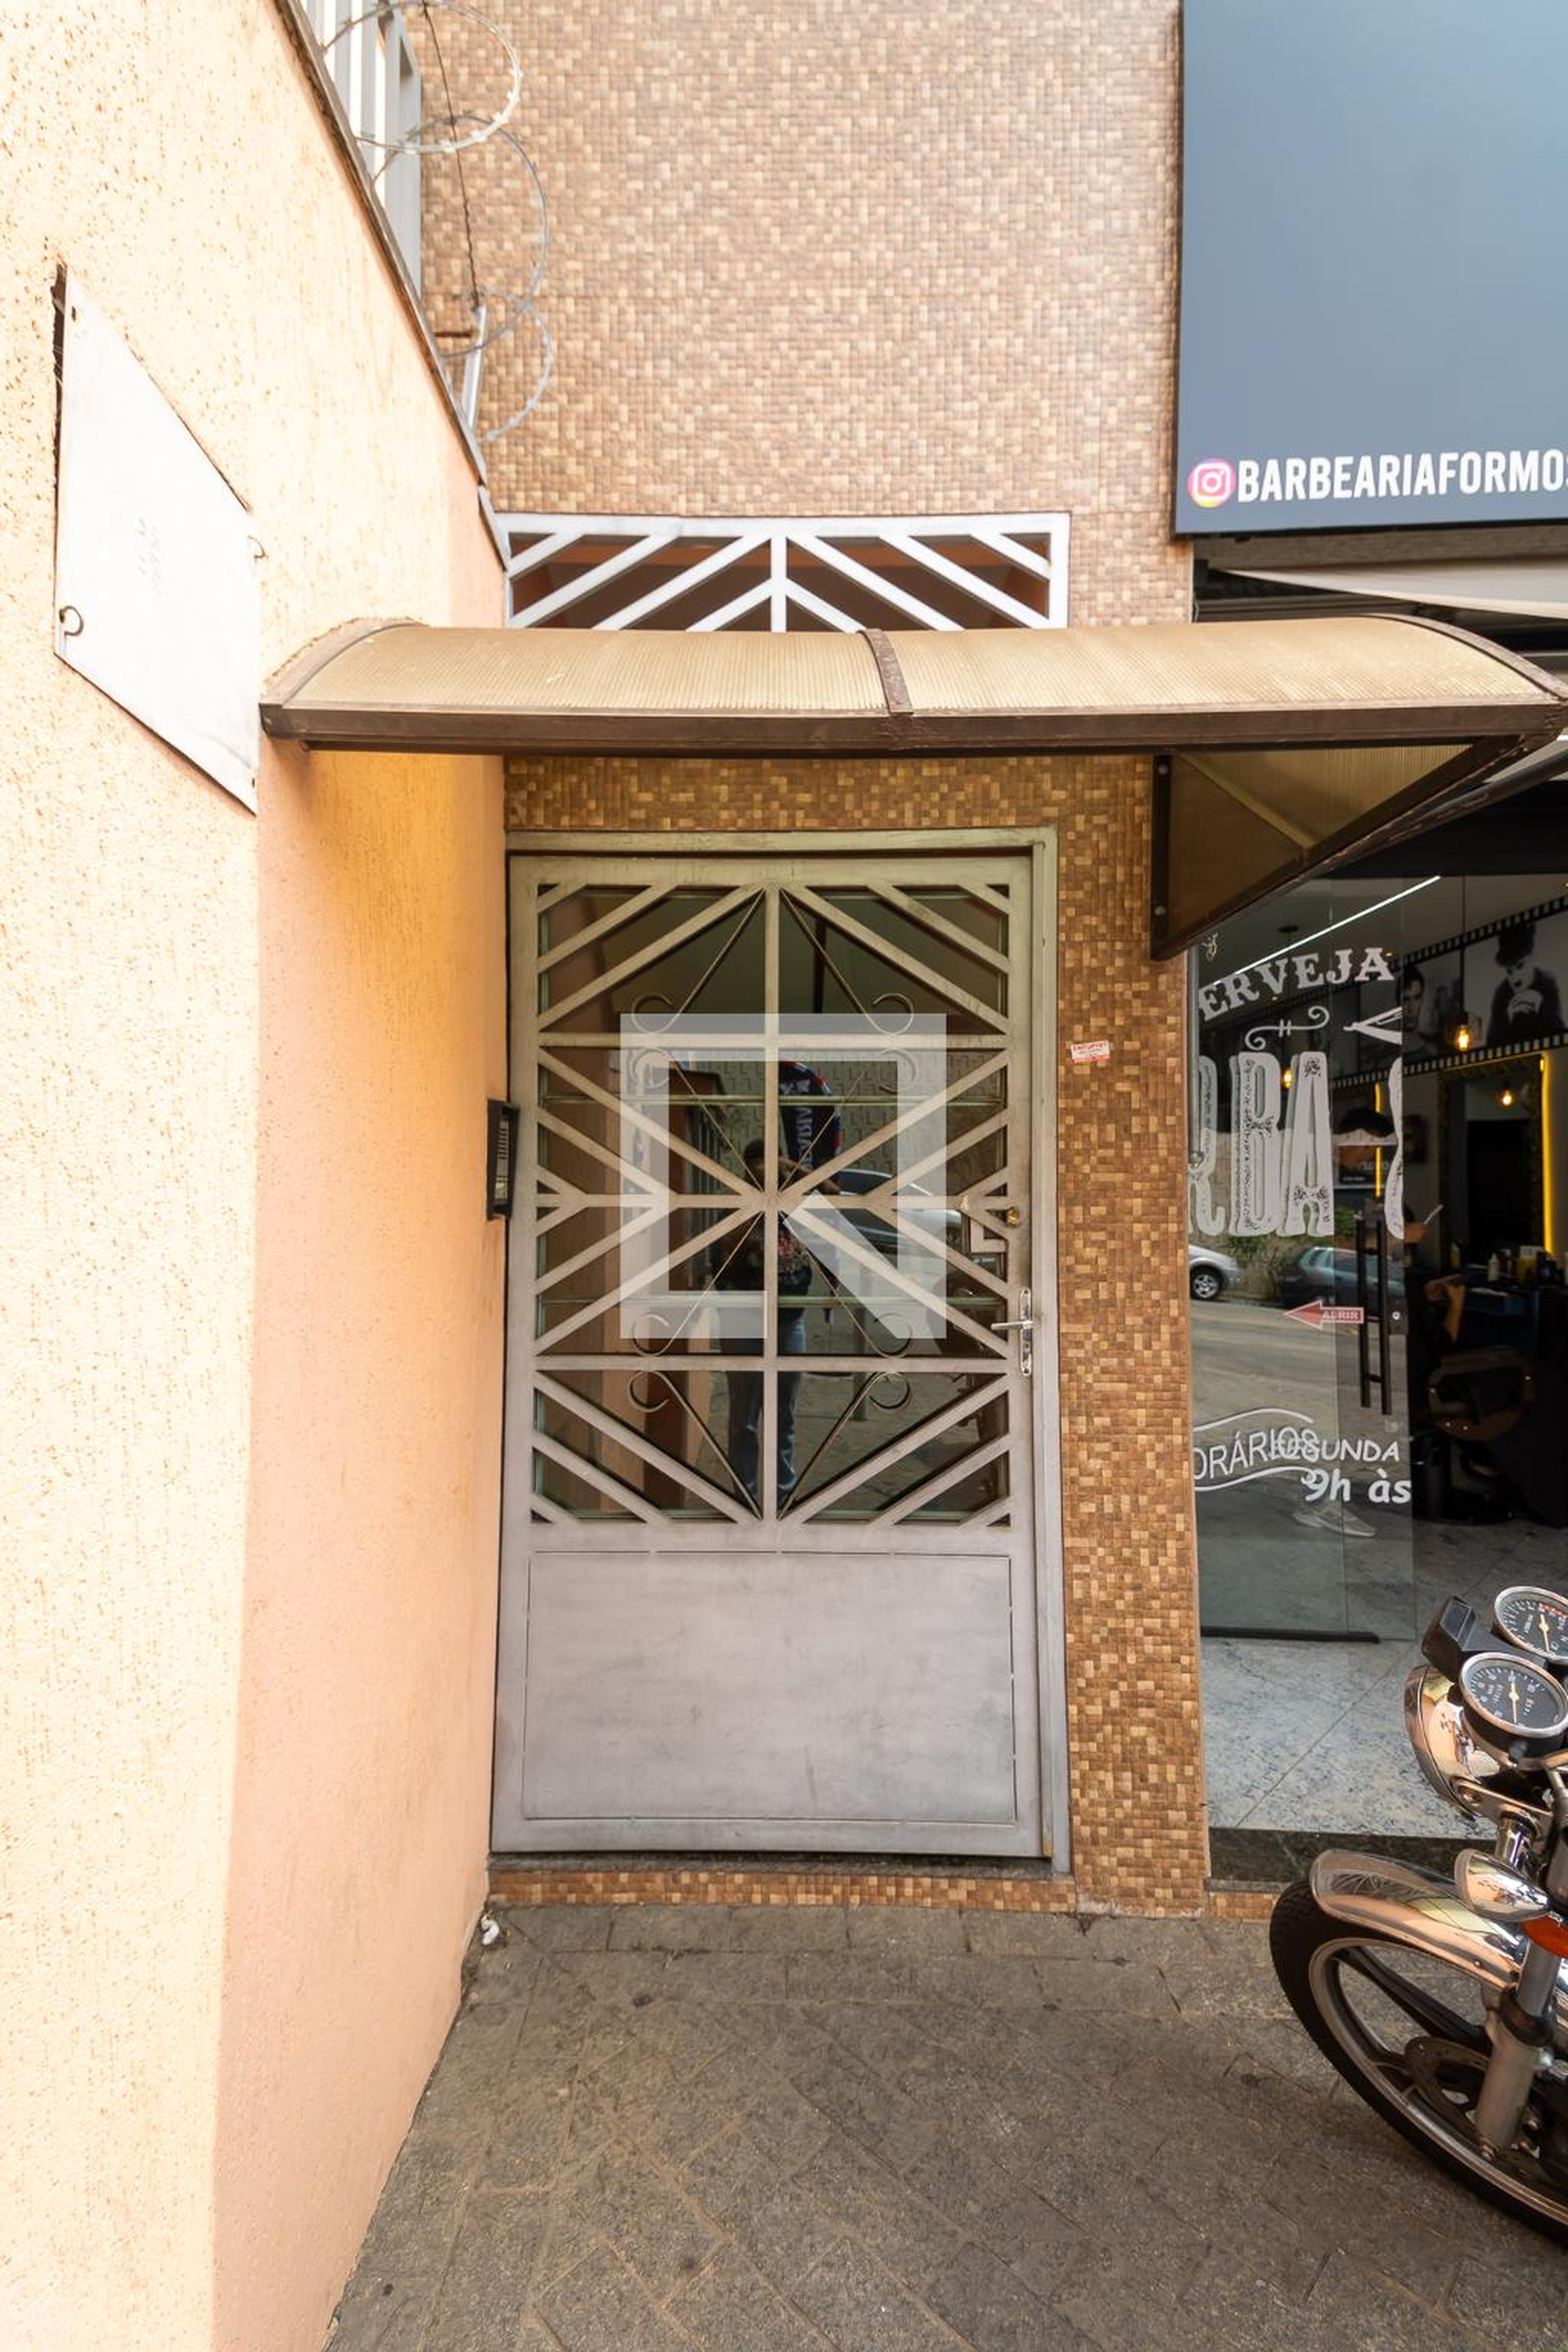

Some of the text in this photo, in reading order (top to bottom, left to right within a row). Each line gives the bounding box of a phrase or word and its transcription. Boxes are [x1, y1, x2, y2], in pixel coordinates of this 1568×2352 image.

[1237, 448, 1568, 503] BARBEARIAFORMO
[1322, 1310, 1359, 1319] ABRIR
[1305, 1468, 1411, 1504] 9h às
